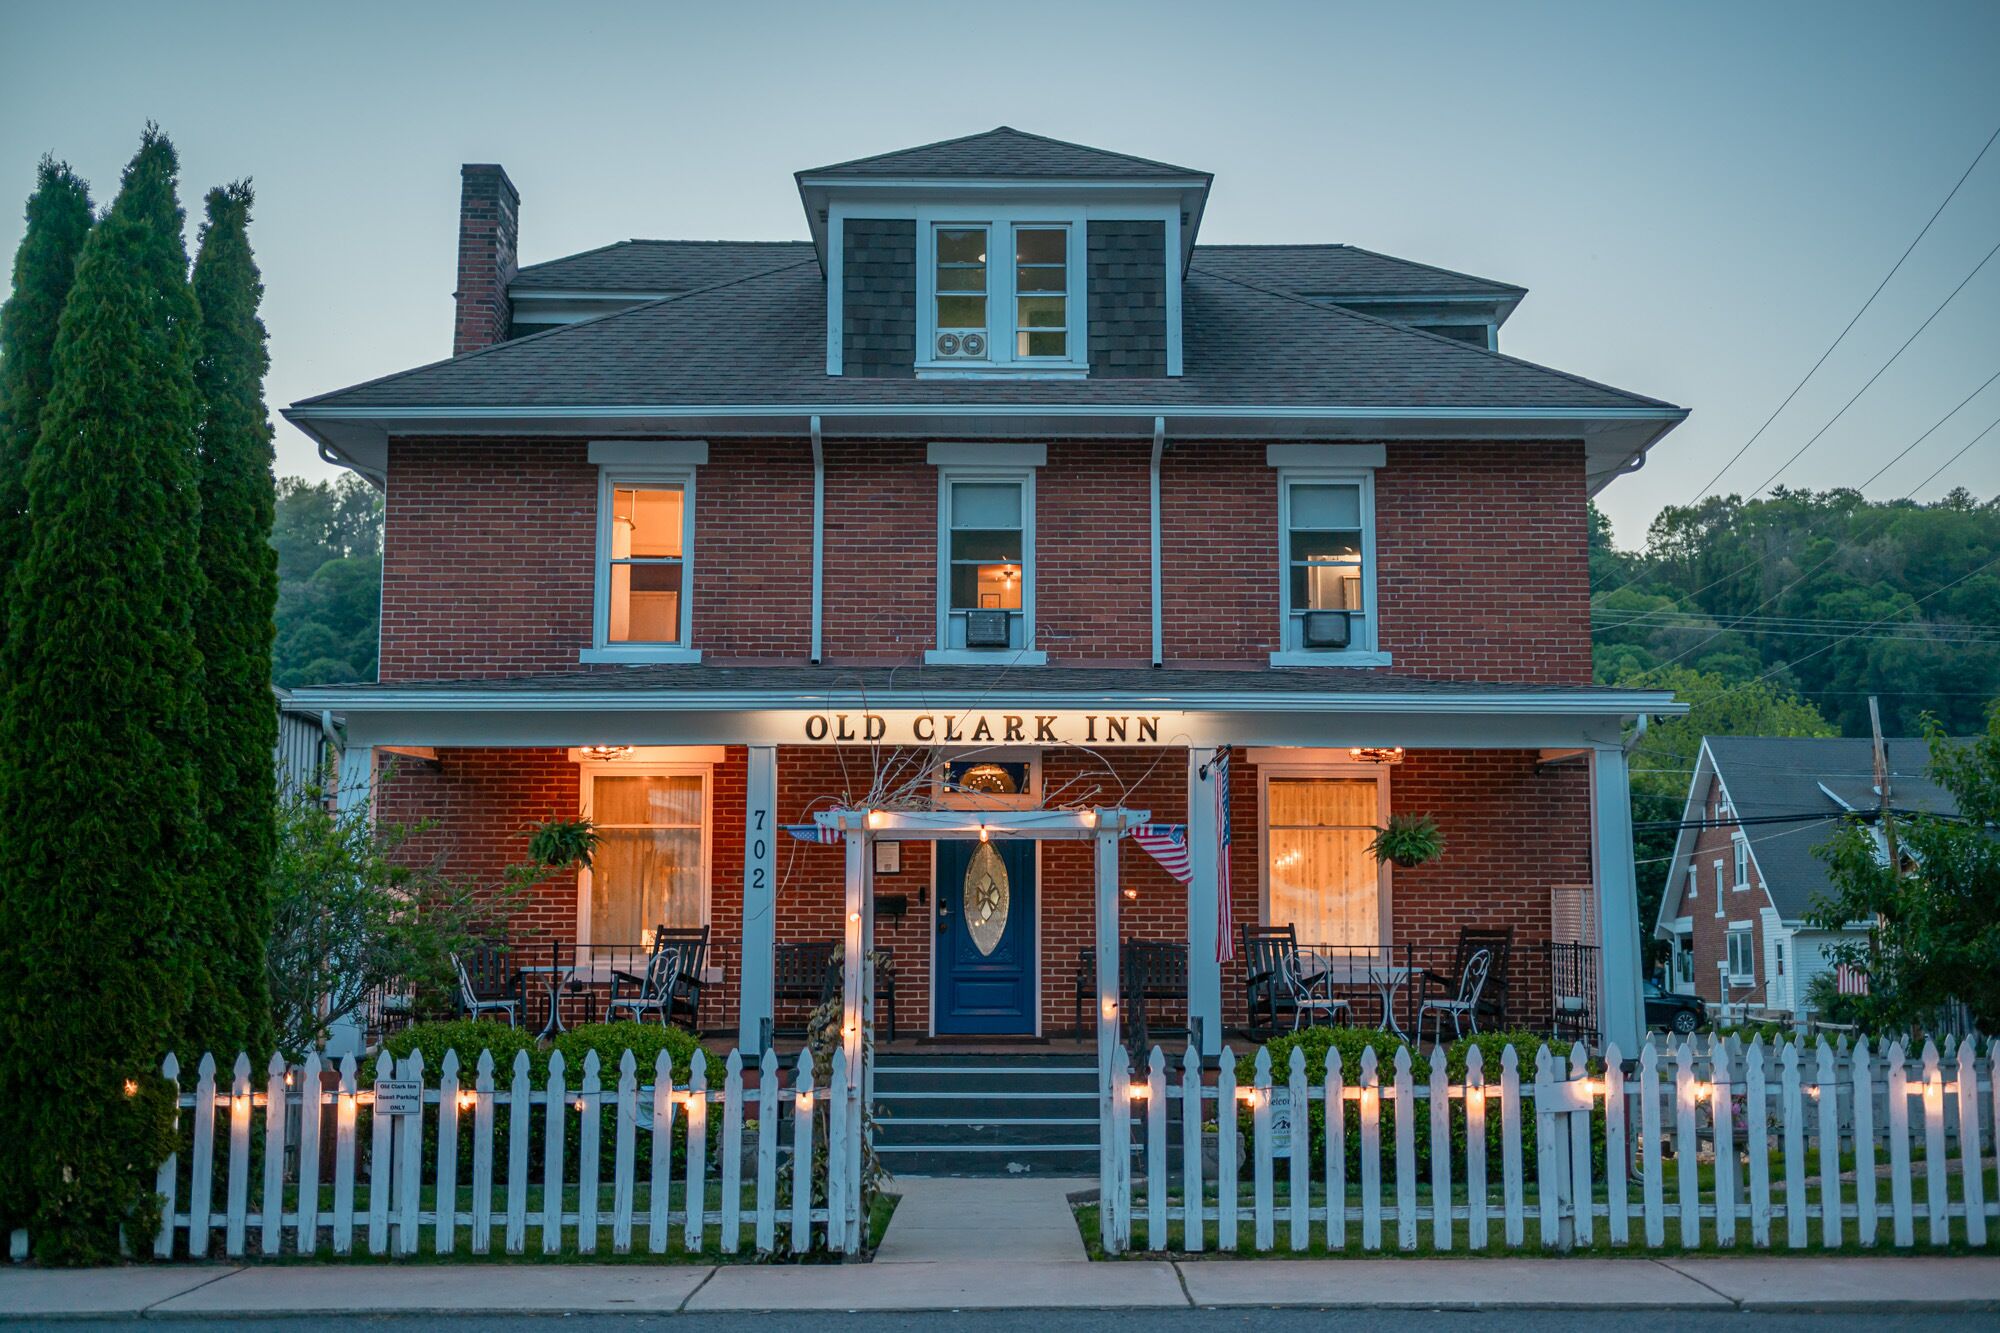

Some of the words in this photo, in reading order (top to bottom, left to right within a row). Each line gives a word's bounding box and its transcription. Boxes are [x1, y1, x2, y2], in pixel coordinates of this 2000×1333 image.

[805, 715, 886, 741] OLD
[913, 715, 1058, 742] CLARK
[1086, 715, 1161, 742] INN
[752, 810, 766, 888] 702
